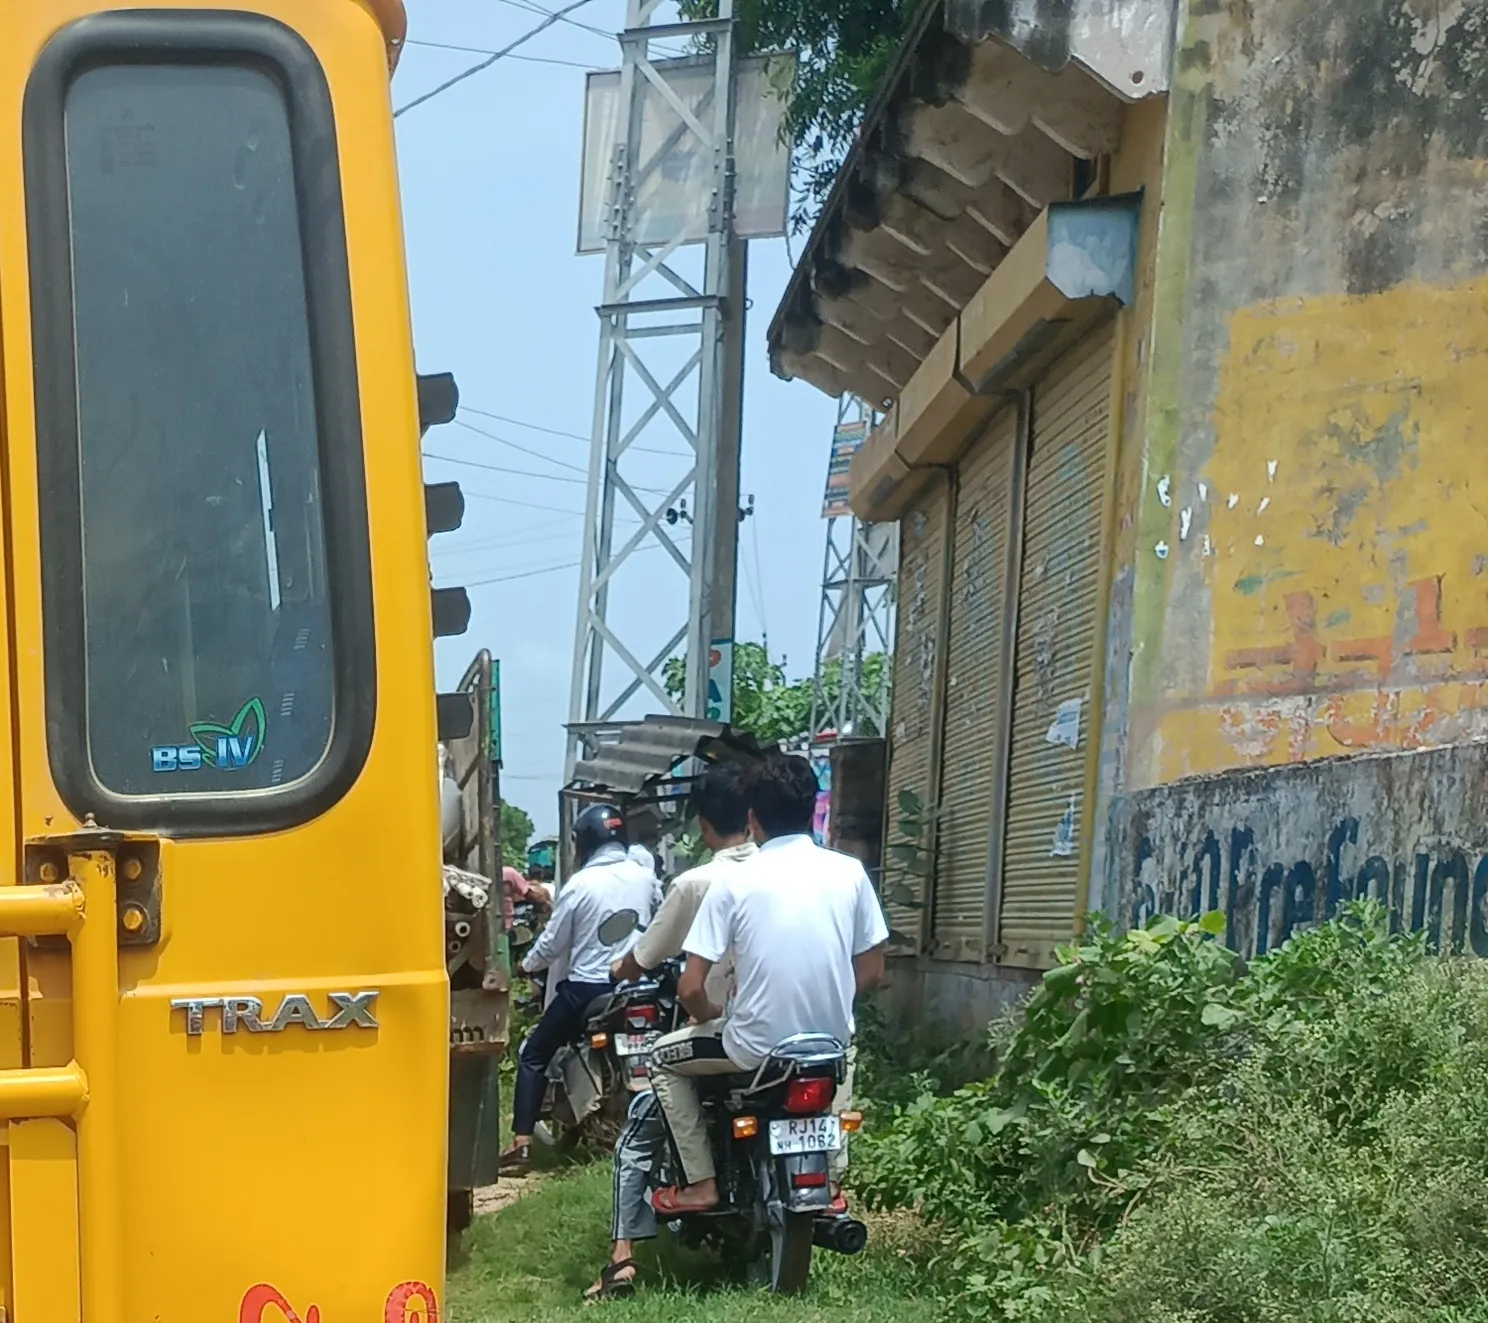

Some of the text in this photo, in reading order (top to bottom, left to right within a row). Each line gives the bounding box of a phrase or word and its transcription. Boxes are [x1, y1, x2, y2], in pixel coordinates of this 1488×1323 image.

[151, 736, 254, 773] BS IV
[170, 991, 381, 1035] TRAX
[788, 1118, 827, 1135] RJ14
